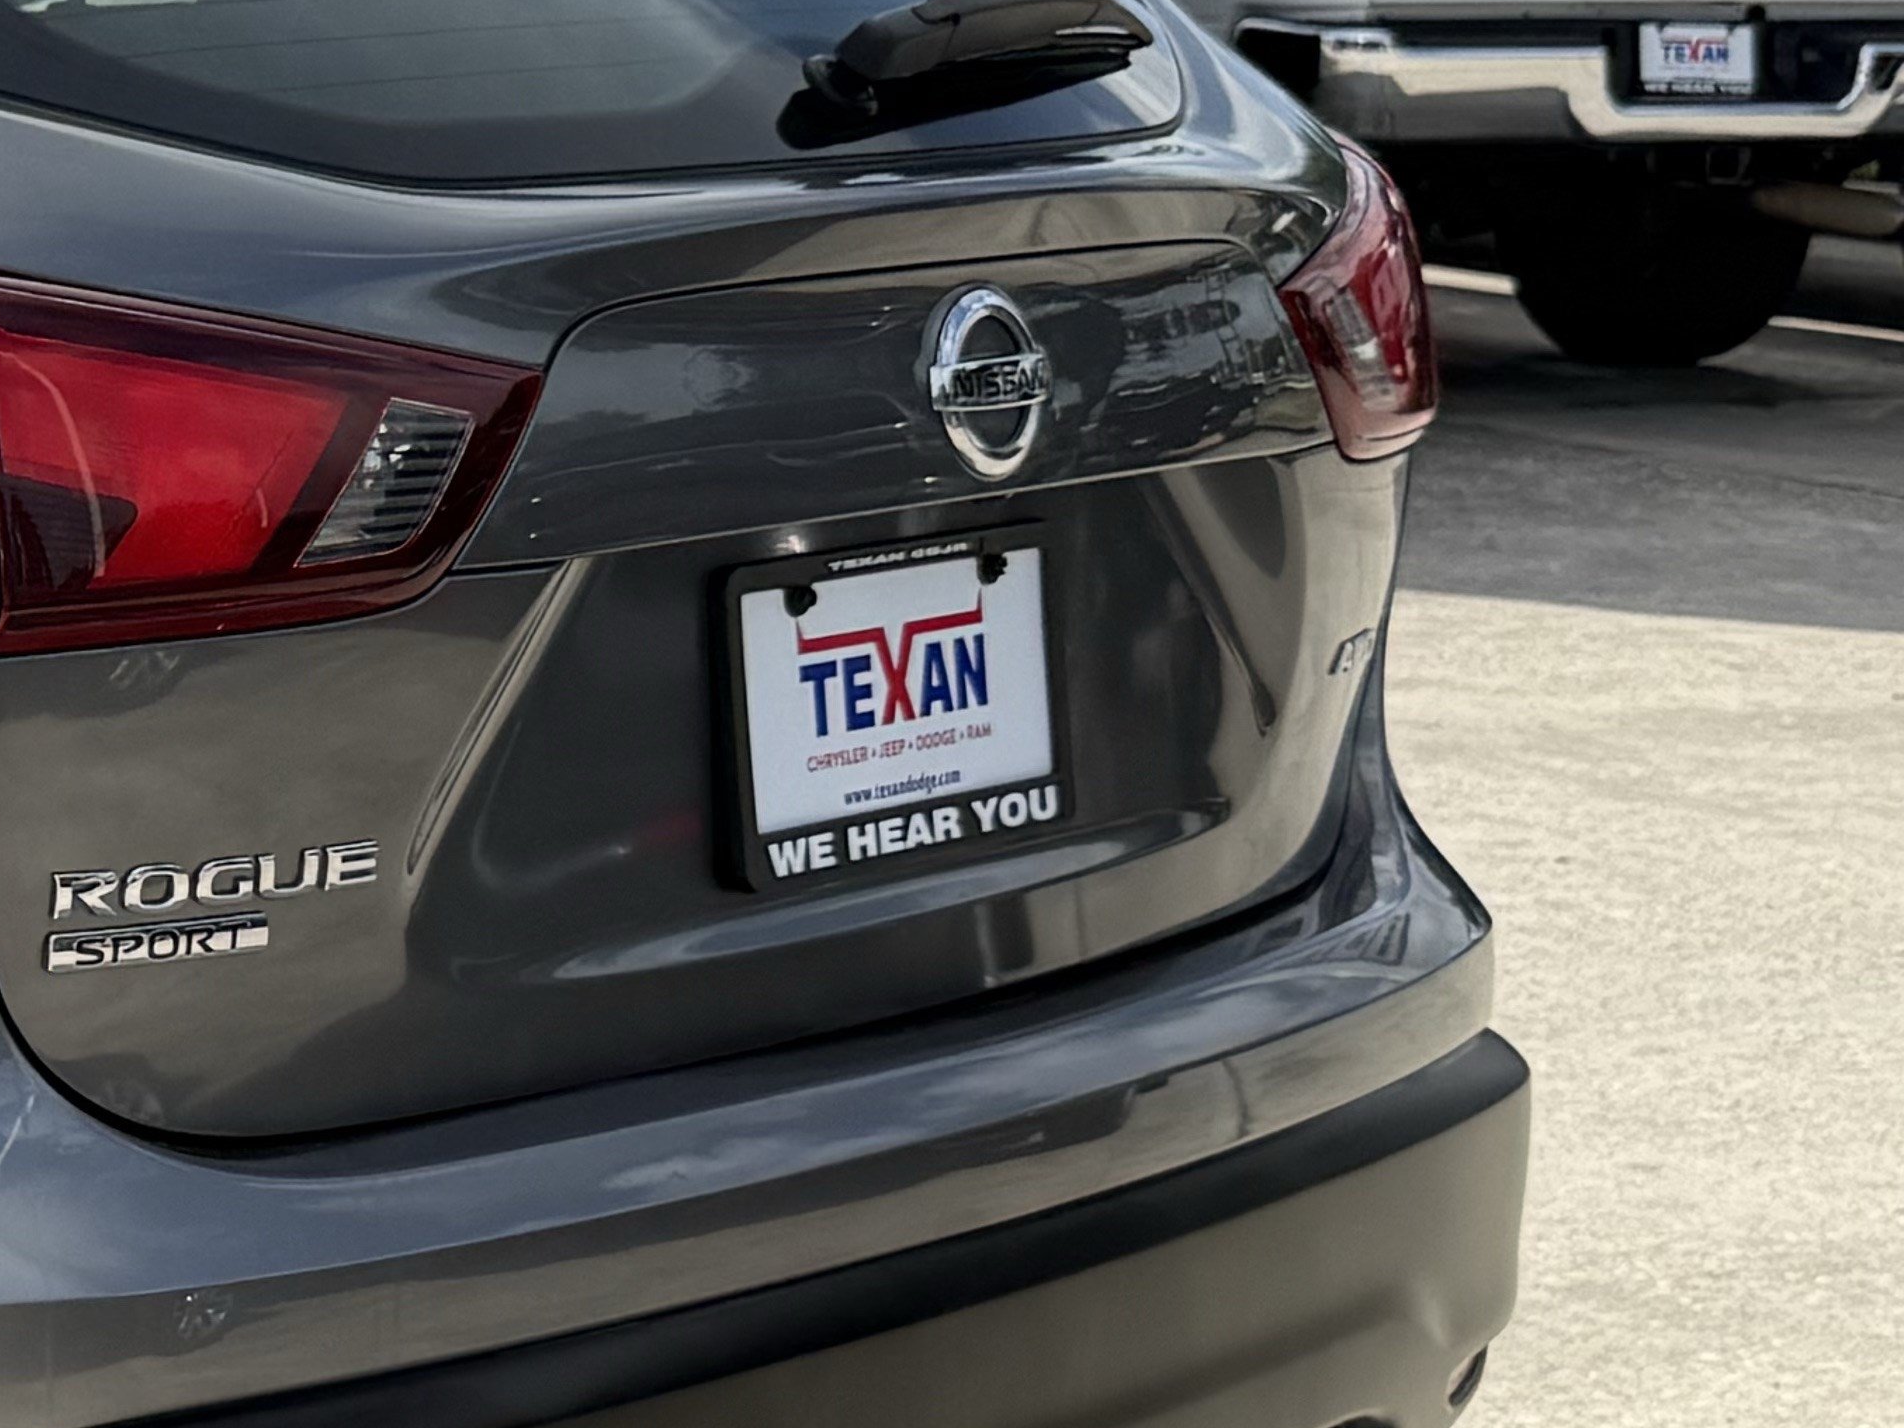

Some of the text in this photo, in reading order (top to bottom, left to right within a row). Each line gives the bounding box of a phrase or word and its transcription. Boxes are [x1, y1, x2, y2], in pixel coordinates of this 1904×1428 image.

[1662, 39, 1730, 64] TEXAN
[828, 550, 905, 572] TEXAN
[797, 608, 989, 737] TEXAN
[807, 723, 992, 772] CHRYSLER JEEP DODGE RAM
[767, 785, 1059, 878] WE HEAR YOU
[51, 838, 380, 920] ROGUE
[72, 918, 253, 969] SPORT
